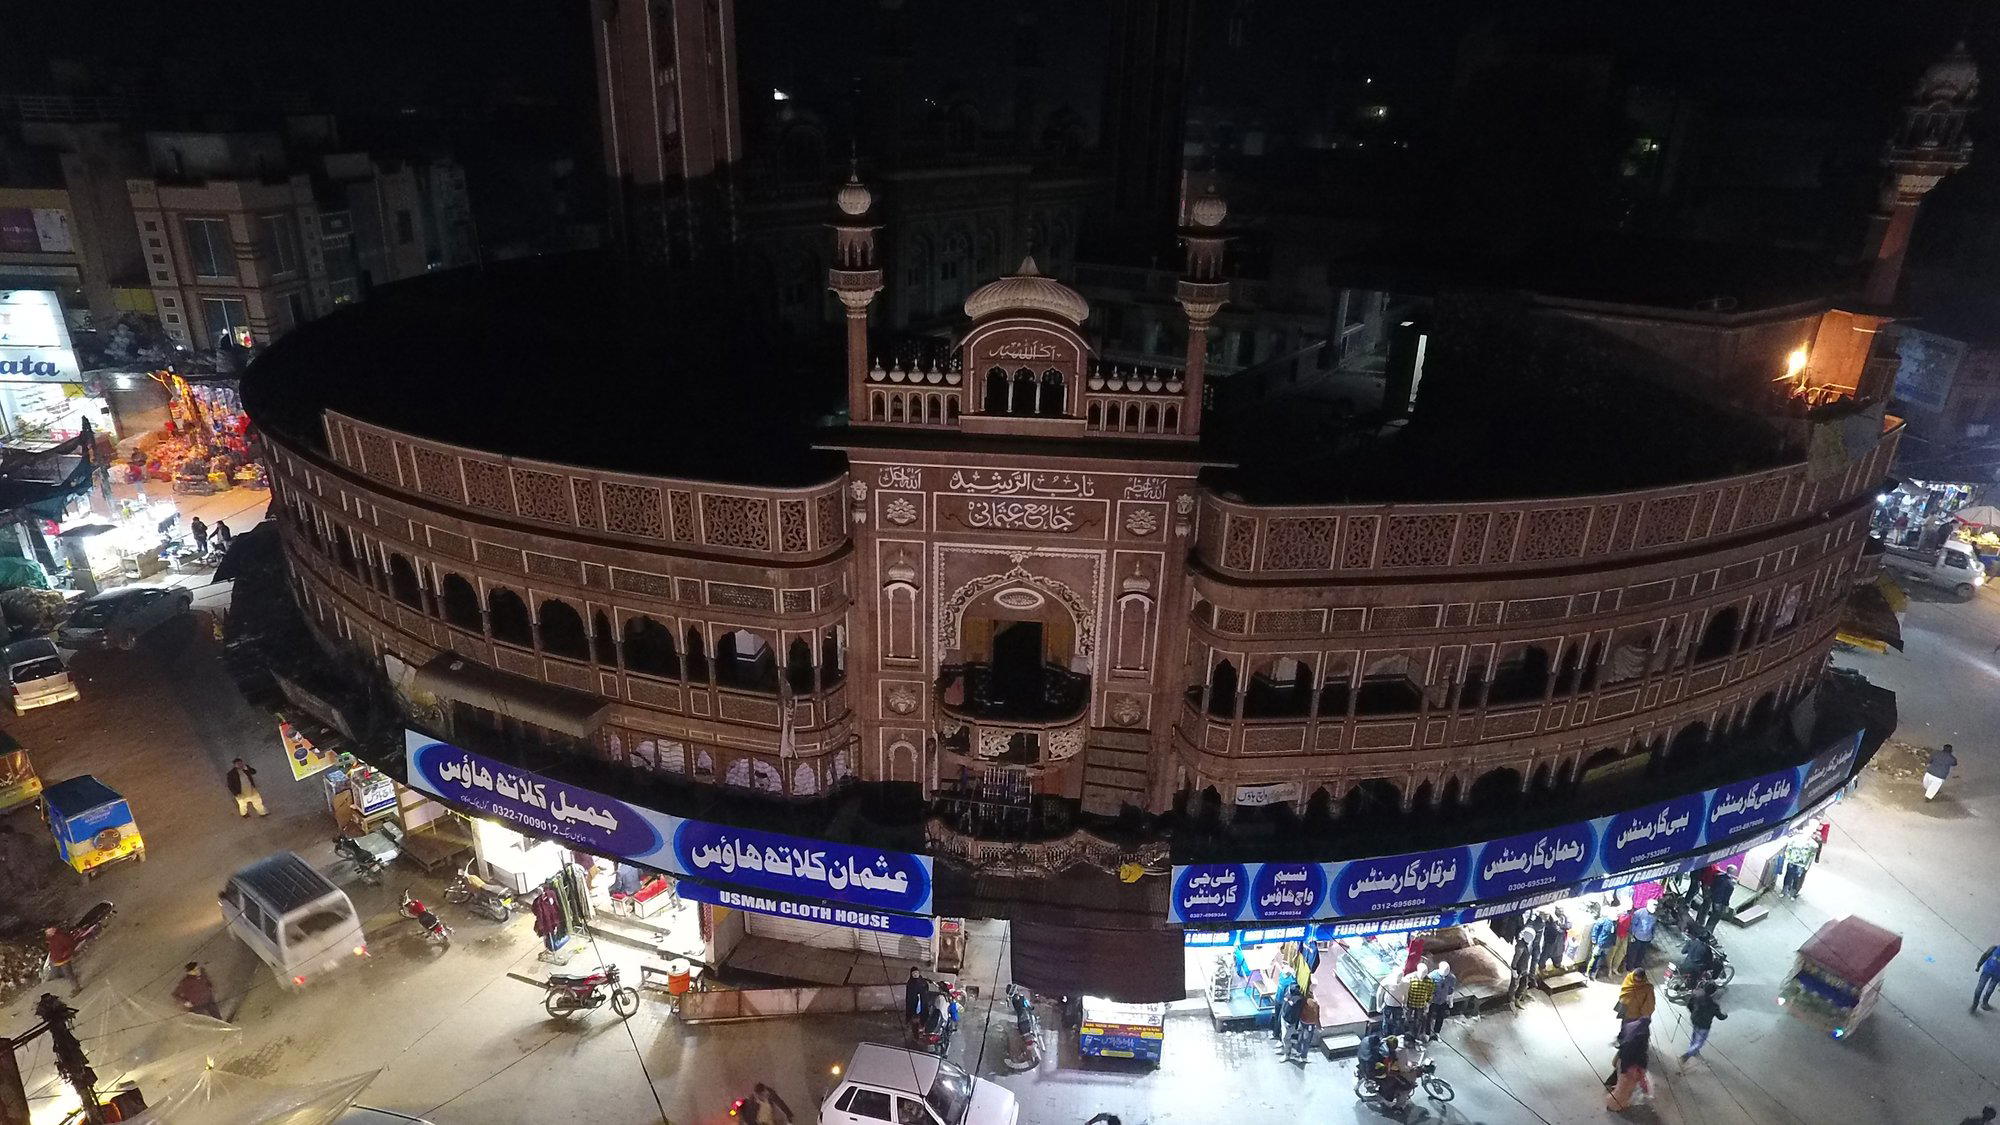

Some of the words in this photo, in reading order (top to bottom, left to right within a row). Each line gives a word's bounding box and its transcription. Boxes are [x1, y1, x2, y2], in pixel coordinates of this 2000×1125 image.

[492, 803, 559, 835] 0322-7009012
[551, 791, 618, 835] جمیل
[1616, 806, 1670, 849] گارمنٹس
[1484, 836, 1547, 880] گارمنٹس
[1544, 838, 1584, 869] رحمان
[828, 855, 909, 893] عثمان
[1189, 872, 1211, 889] جی
[1210, 868, 1236, 888] علی
[1274, 866, 1308, 886] نسیم
[1348, 859, 1421, 899] گارمنٹس
[1417, 858, 1457, 890] فرقان
[1633, 862, 1681, 882] GARMENTS
[720, 890, 777, 912] USMAN
[780, 900, 832, 920] CLOTH
[835, 909, 890, 929] HOUSE
[1184, 885, 1238, 908] گارمنٹس
[1294, 887, 1314, 906] واچ
[1474, 901, 1519, 919] RAHMAN
[1519, 888, 1571, 910] GARMENTS
[1333, 921, 1379, 936] FURQAN
[1380, 915, 1441, 932] GARMENTS
